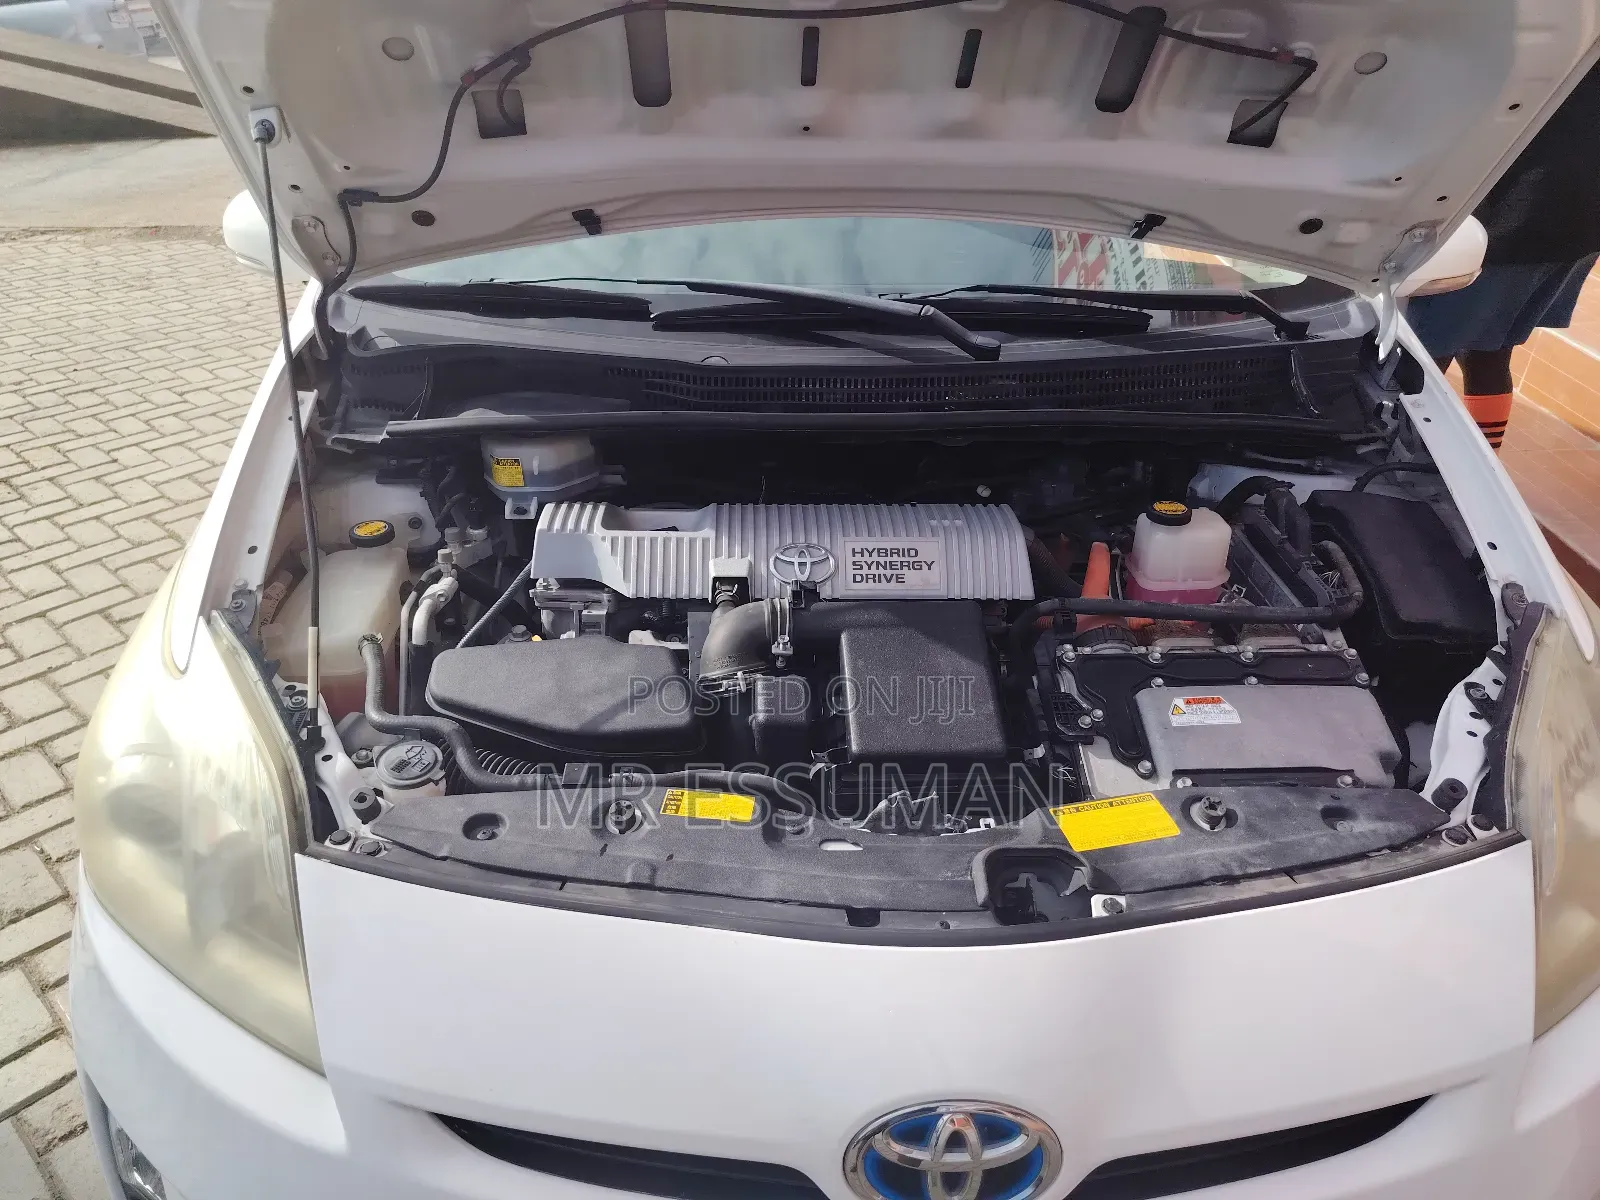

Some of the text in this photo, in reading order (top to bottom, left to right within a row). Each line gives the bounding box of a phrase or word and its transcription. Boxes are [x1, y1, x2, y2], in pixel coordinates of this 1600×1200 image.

[851, 547, 919, 558] HYBRID
[851, 560, 936, 571] SYNERGY
[852, 573, 906, 584] DRIVE
[1078, 802, 1110, 812] CAUTION
[1112, 795, 1153, 807] ATTENTION
